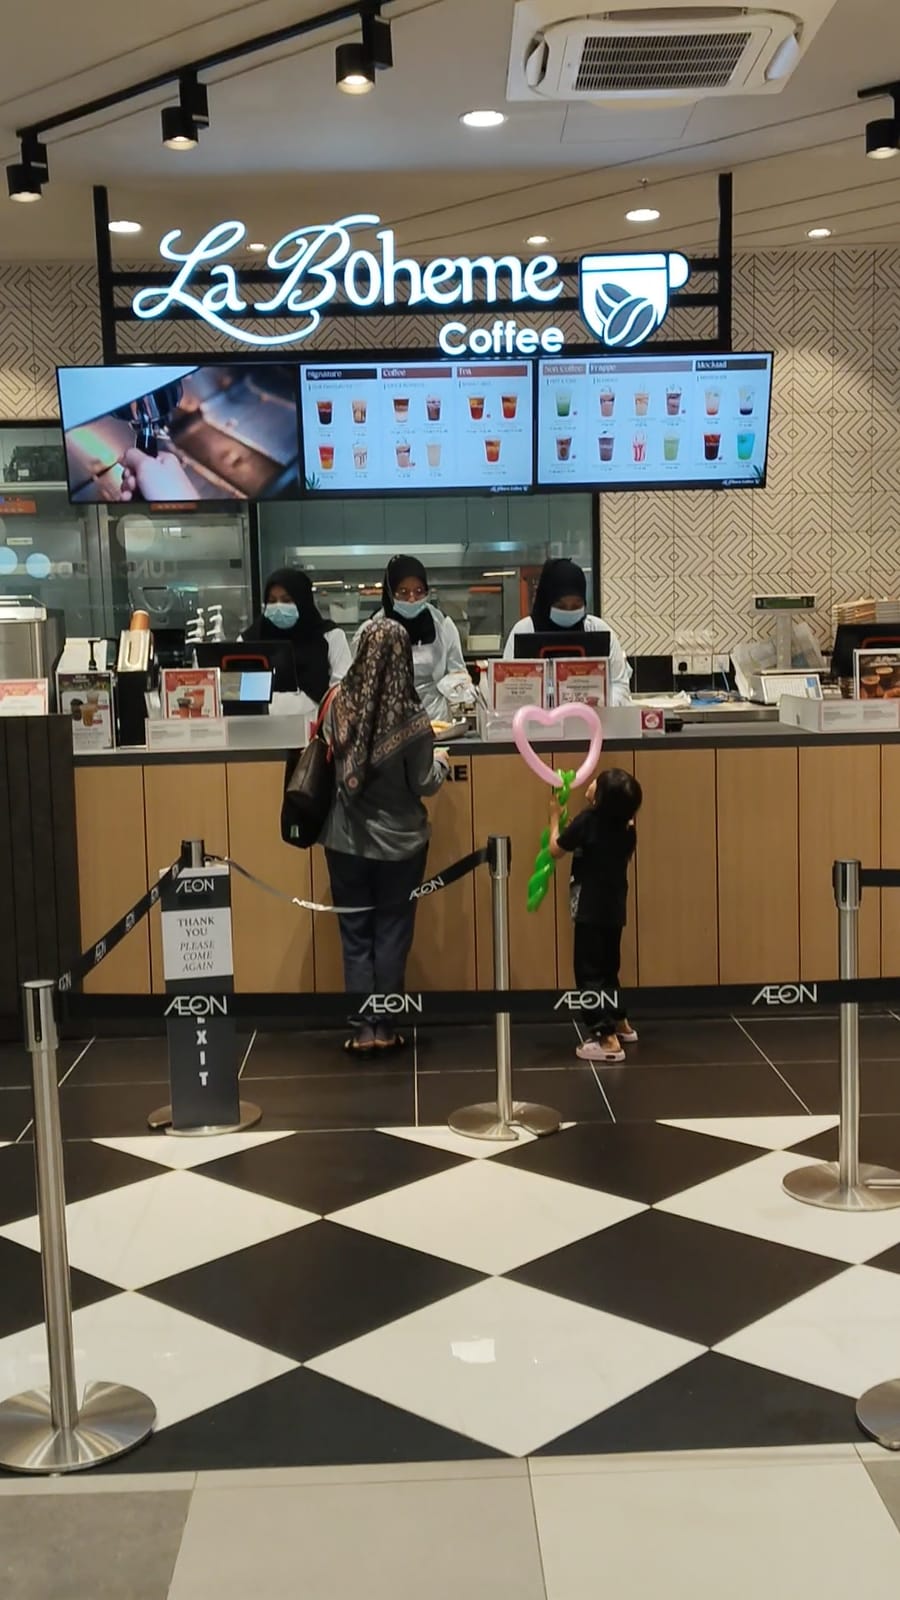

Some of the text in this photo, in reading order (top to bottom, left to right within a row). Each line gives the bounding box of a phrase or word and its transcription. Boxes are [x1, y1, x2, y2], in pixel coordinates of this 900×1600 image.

[131, 213, 564, 345] La Boheme
[438, 320, 564, 355] Coffee
[382, 368, 407, 378] Coffee
[177, 916, 215, 927] THANK
[185, 928, 208, 937] YOU
[180, 940, 214, 951] PLEASE
[183, 951, 212, 961] COME
[182, 961, 213, 972] AGAIN
